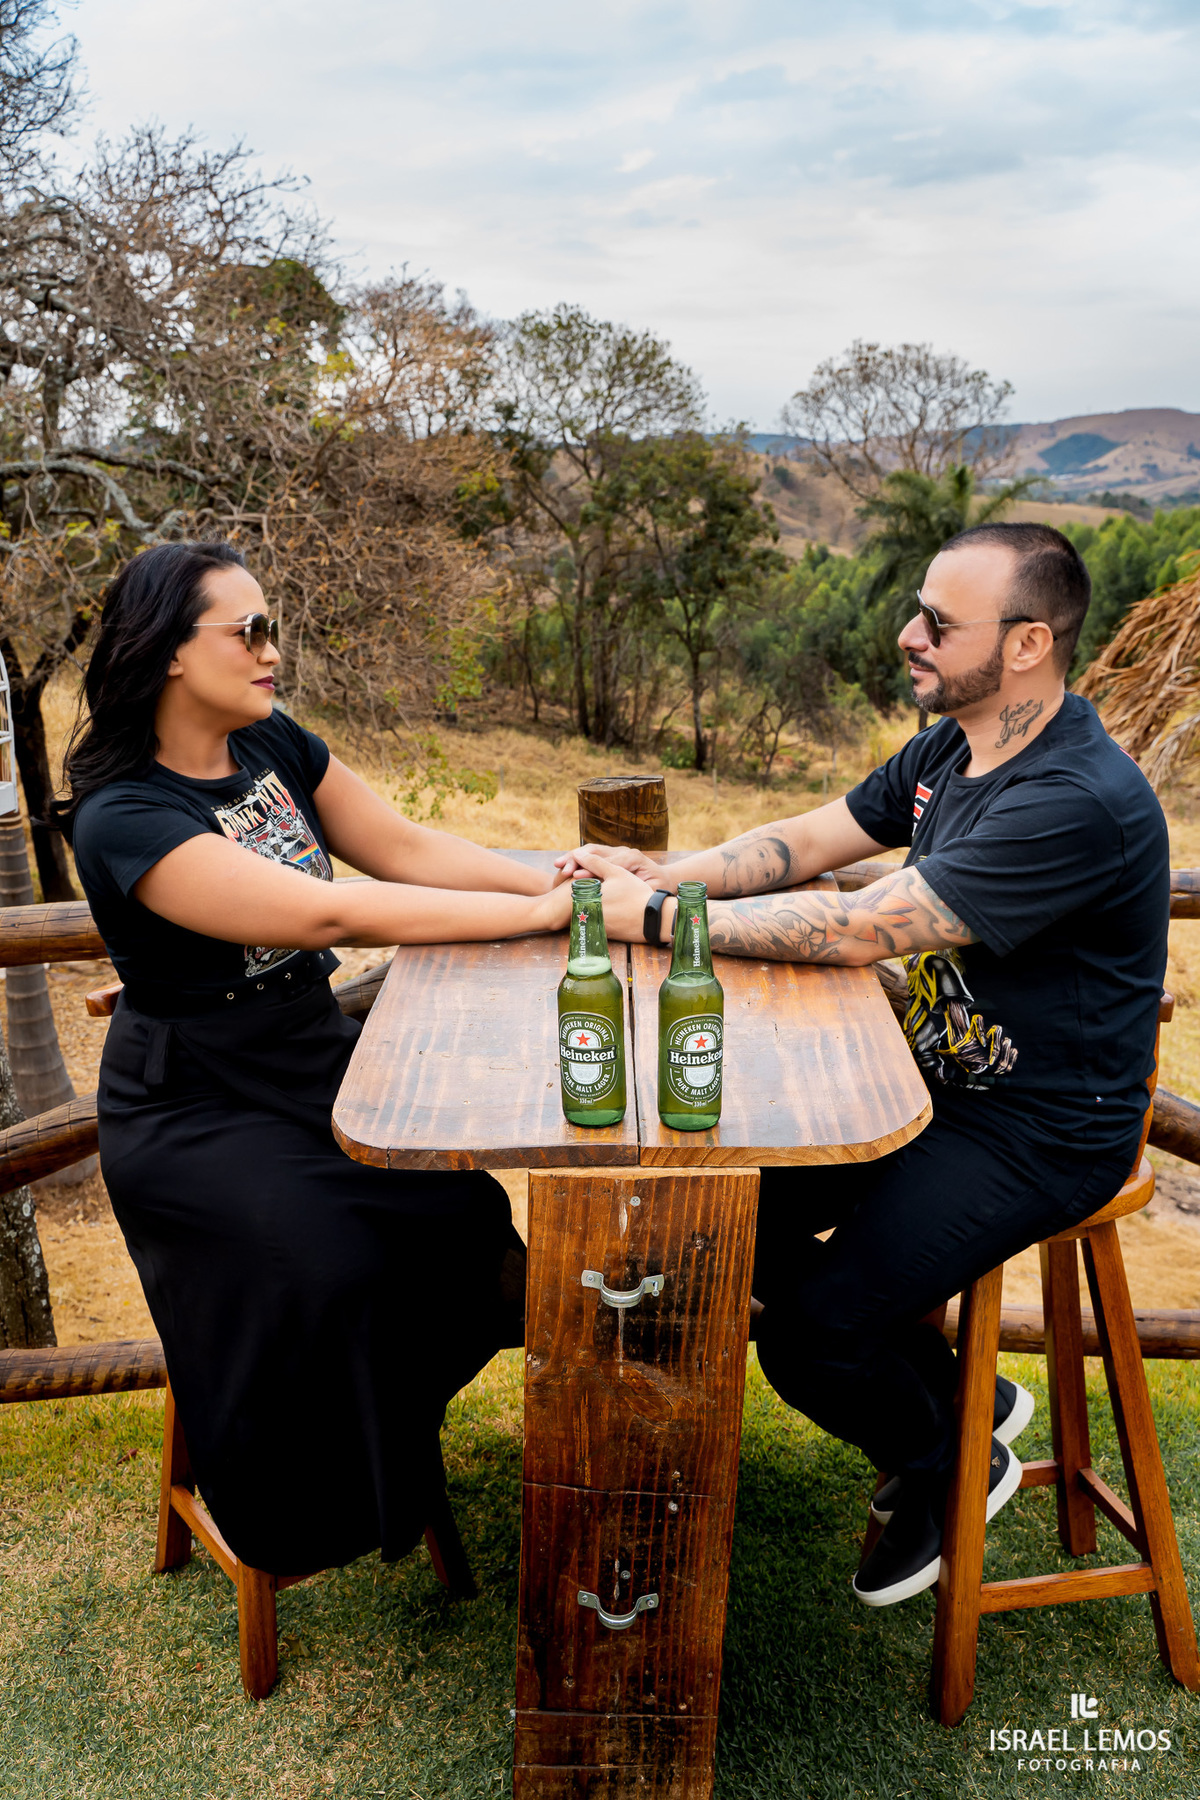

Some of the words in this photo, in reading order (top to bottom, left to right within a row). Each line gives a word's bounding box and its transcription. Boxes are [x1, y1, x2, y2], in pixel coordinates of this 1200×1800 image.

[692, 927, 701, 968] Heineken
[561, 1020, 583, 1040] HEINEKEN
[584, 1021, 610, 1042] ORIGINAL
[674, 1023, 702, 1046] HEINEKEN
[560, 1044, 616, 1062] Heineken
[564, 1071, 576, 1089] PURE
[575, 1084, 593, 1093] MALT
[593, 1073, 611, 1091] LAGER
[675, 1077, 690, 1093] PURE
[690, 1087, 708, 1096] MALT
